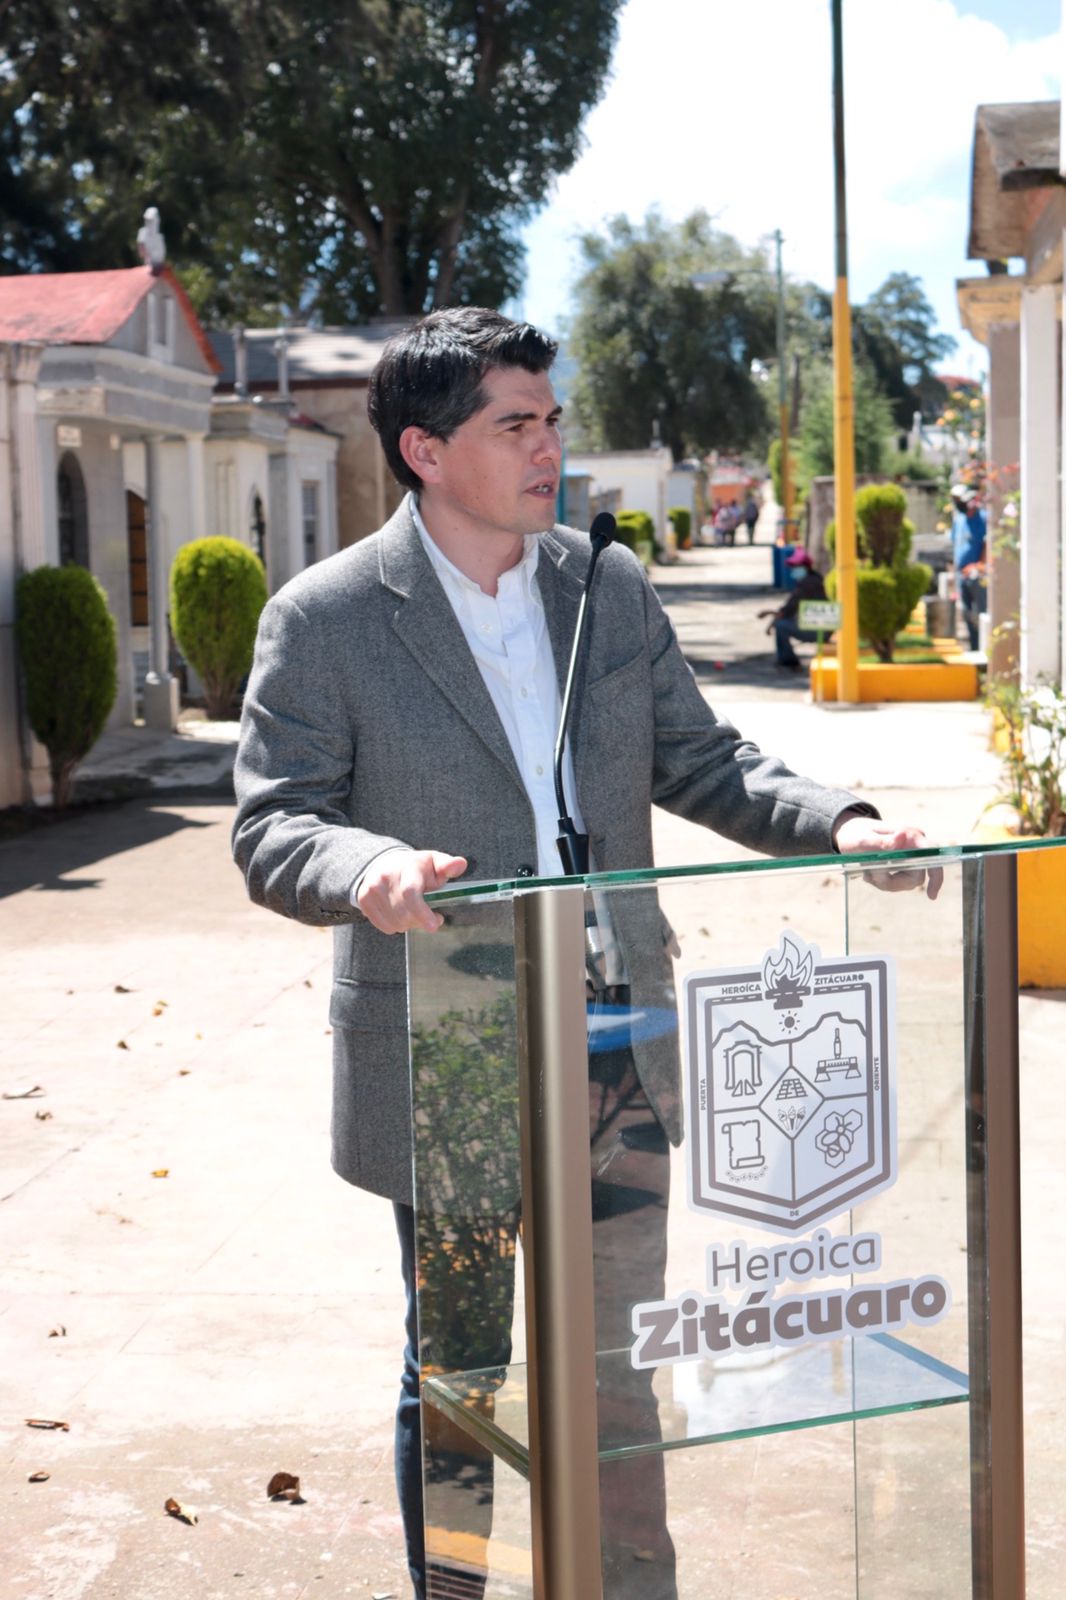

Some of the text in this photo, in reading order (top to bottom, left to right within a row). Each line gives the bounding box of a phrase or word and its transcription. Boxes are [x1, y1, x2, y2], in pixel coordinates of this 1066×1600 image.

[815, 973, 865, 986] ZITÁCUARO
[712, 1235, 876, 1287] Heroica
[639, 1280, 947, 1363] Zitácuaro
